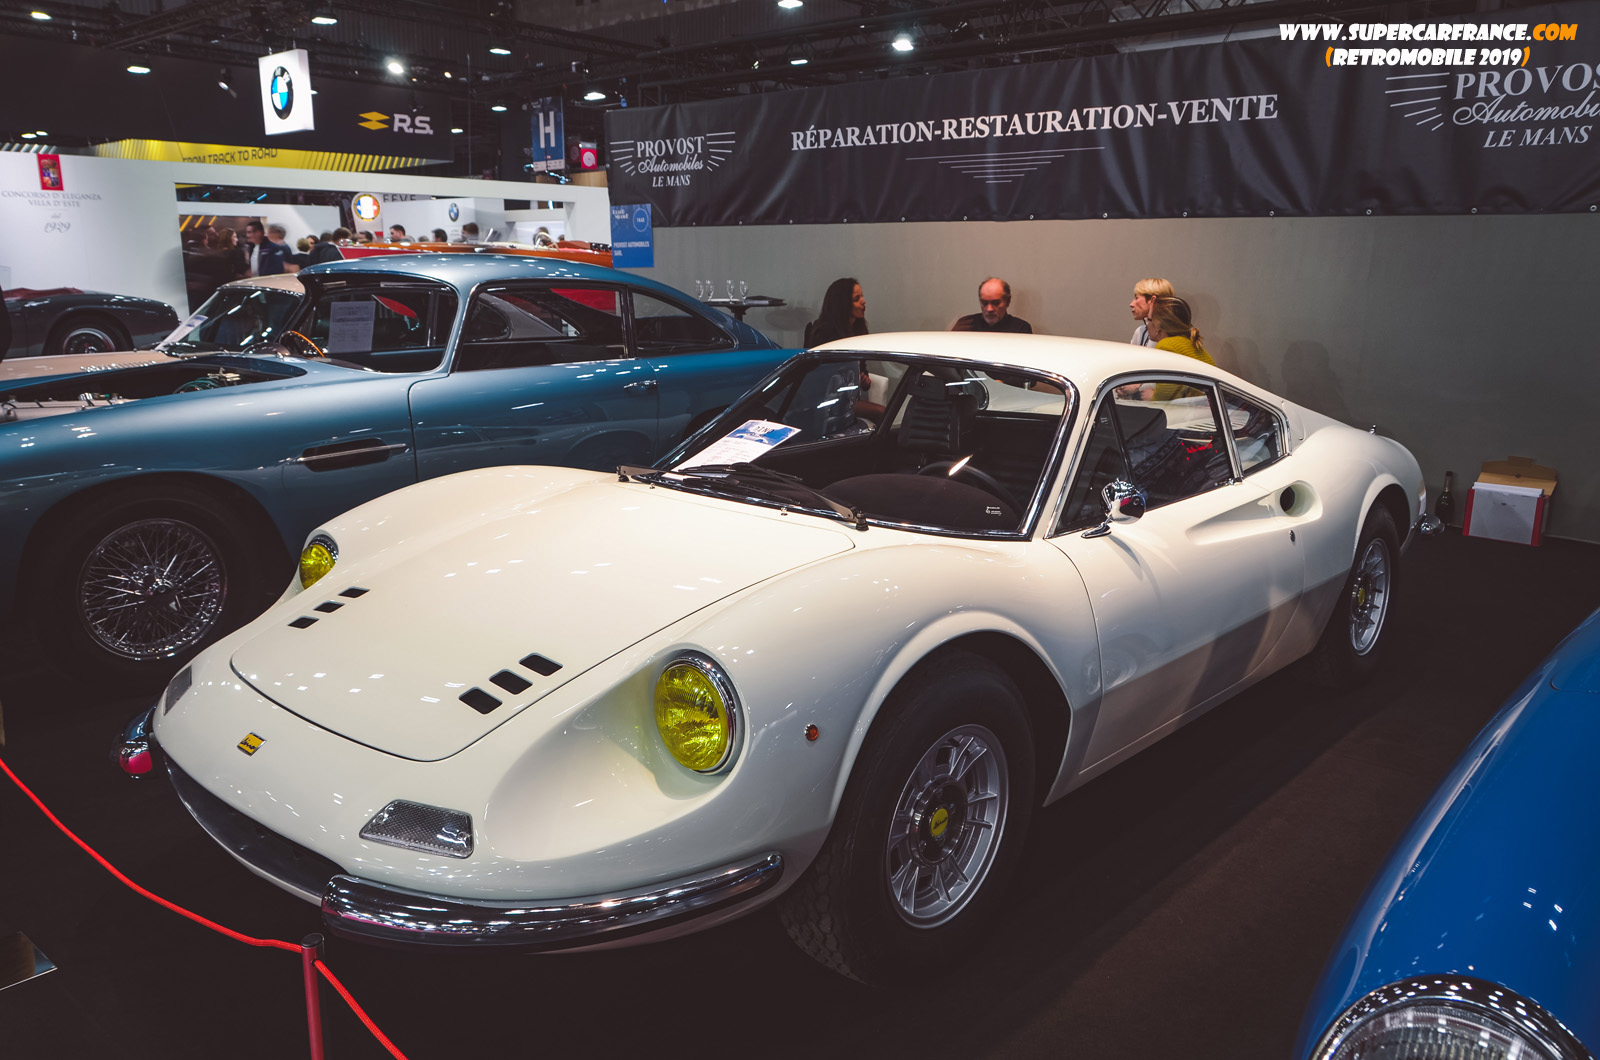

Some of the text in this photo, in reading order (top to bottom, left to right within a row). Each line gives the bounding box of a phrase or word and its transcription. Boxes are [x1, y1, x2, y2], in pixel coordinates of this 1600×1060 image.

[538, 110, 556, 149] H
[791, 94, 1278, 150] RÉPARATION-RESTAURATION-VENTE
[637, 136, 705, 158] PROVOST
[1483, 125, 1593, 149] LE MANS
[237, 150, 250, 161] TO
[251, 147, 278, 160] ROAD
[638, 154, 704, 174] Automobiles
[652, 174, 691, 188] LE MANS
[1, 190, 50, 199] CONCORSO
